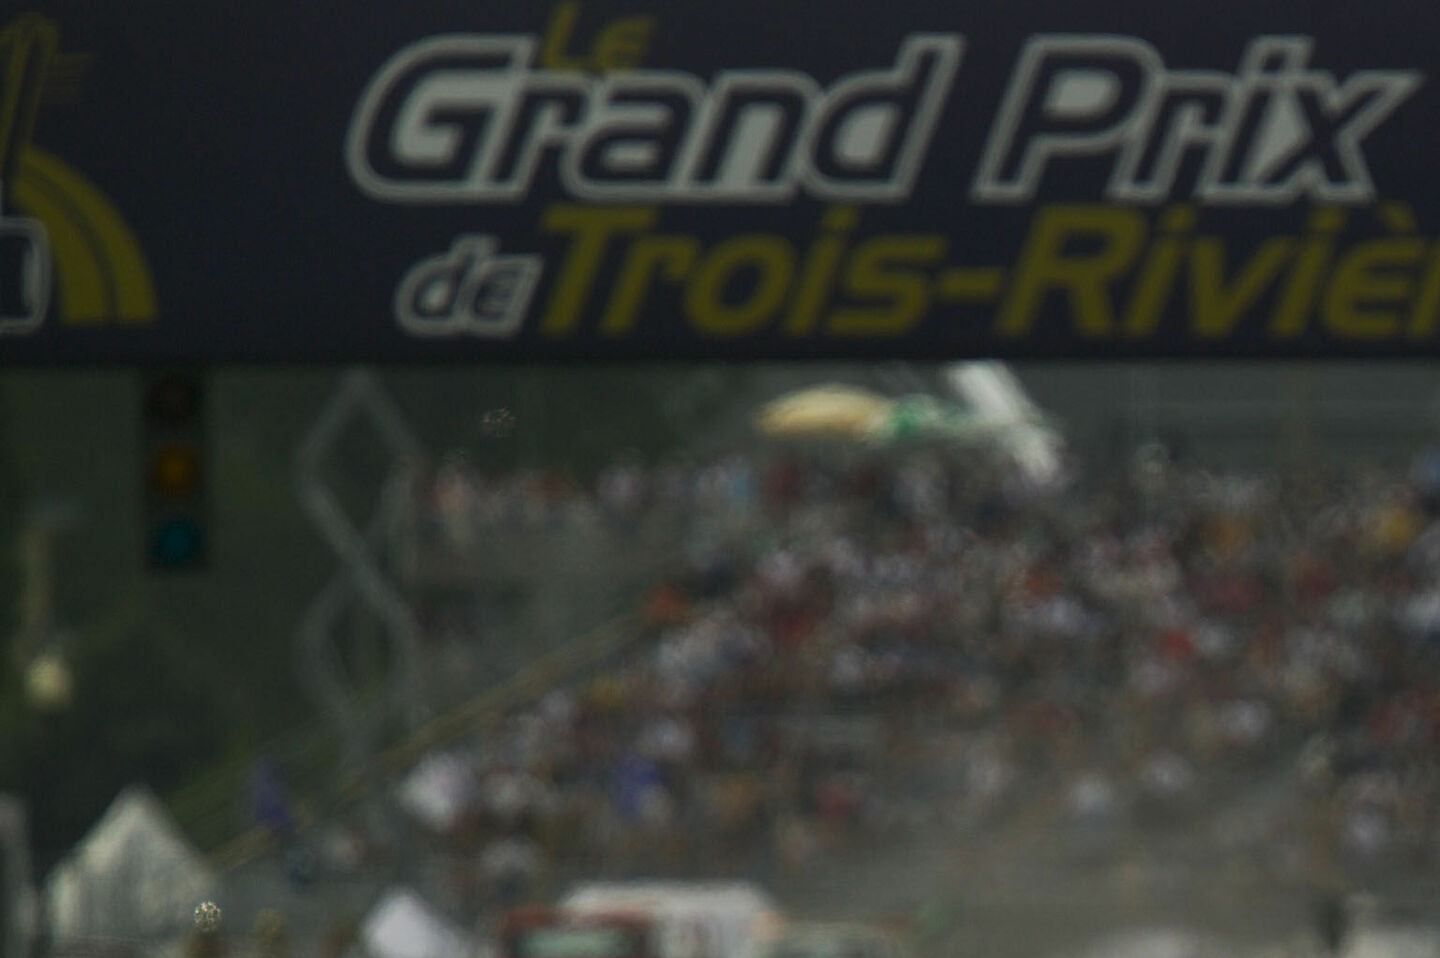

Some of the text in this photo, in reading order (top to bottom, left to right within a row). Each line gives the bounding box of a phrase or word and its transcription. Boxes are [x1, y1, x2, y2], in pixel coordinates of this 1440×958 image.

[541, 5, 657, 70] Le
[344, 33, 1425, 202] Grand Prix
[395, 234, 543, 338] de
